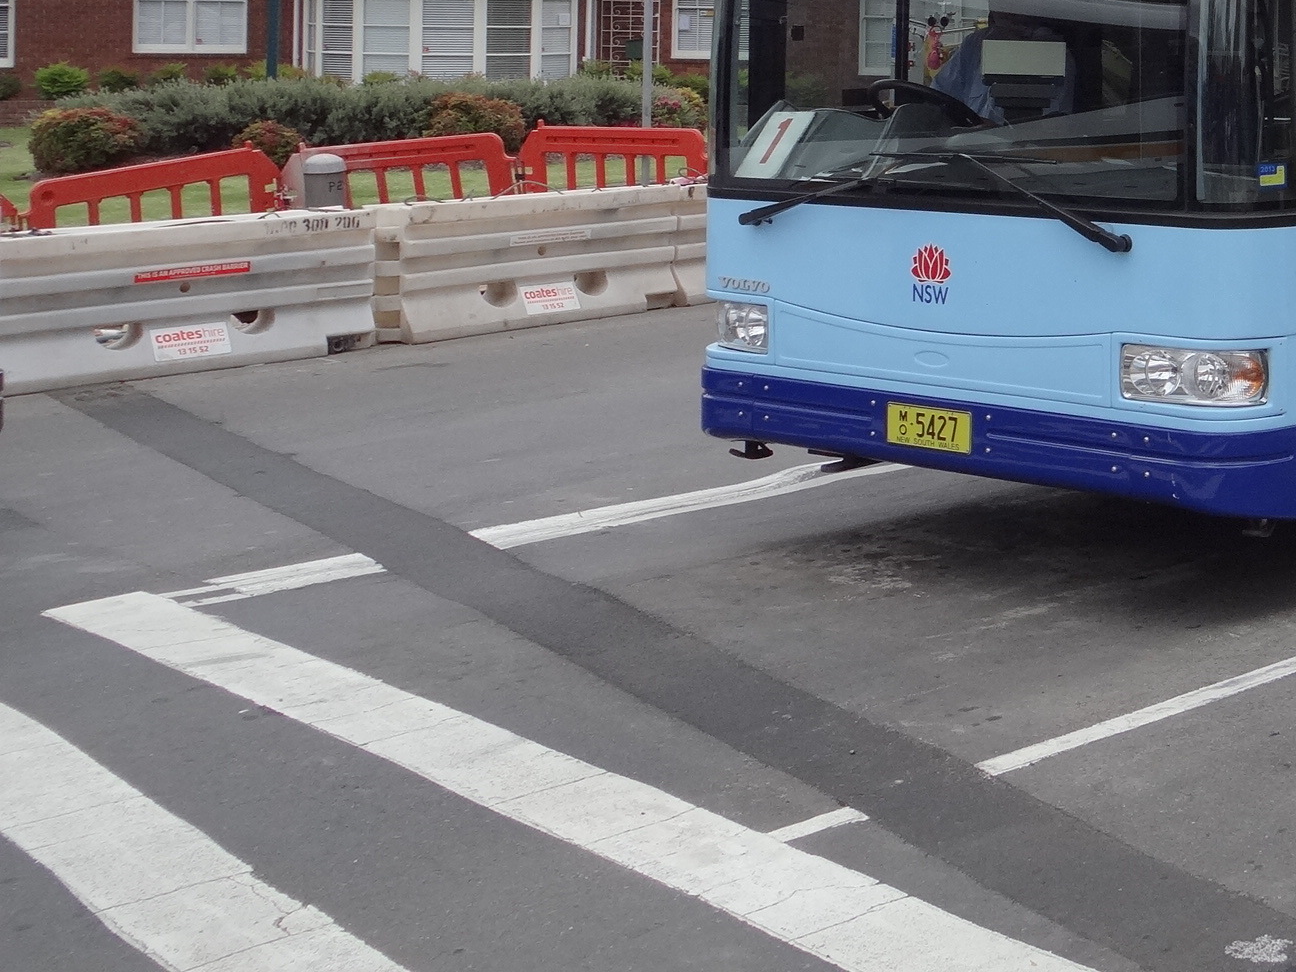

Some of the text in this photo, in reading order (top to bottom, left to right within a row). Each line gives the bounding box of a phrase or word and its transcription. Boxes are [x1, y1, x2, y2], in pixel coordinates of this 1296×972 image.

[759, 118, 794, 164] 1
[718, 276, 770, 293] VOLVO
[912, 283, 949, 304] NSW
[199, 345, 209, 353] 52
[916, 412, 958, 442] 5427
[896, 436, 960, 450] NEW SOUTH WALES
